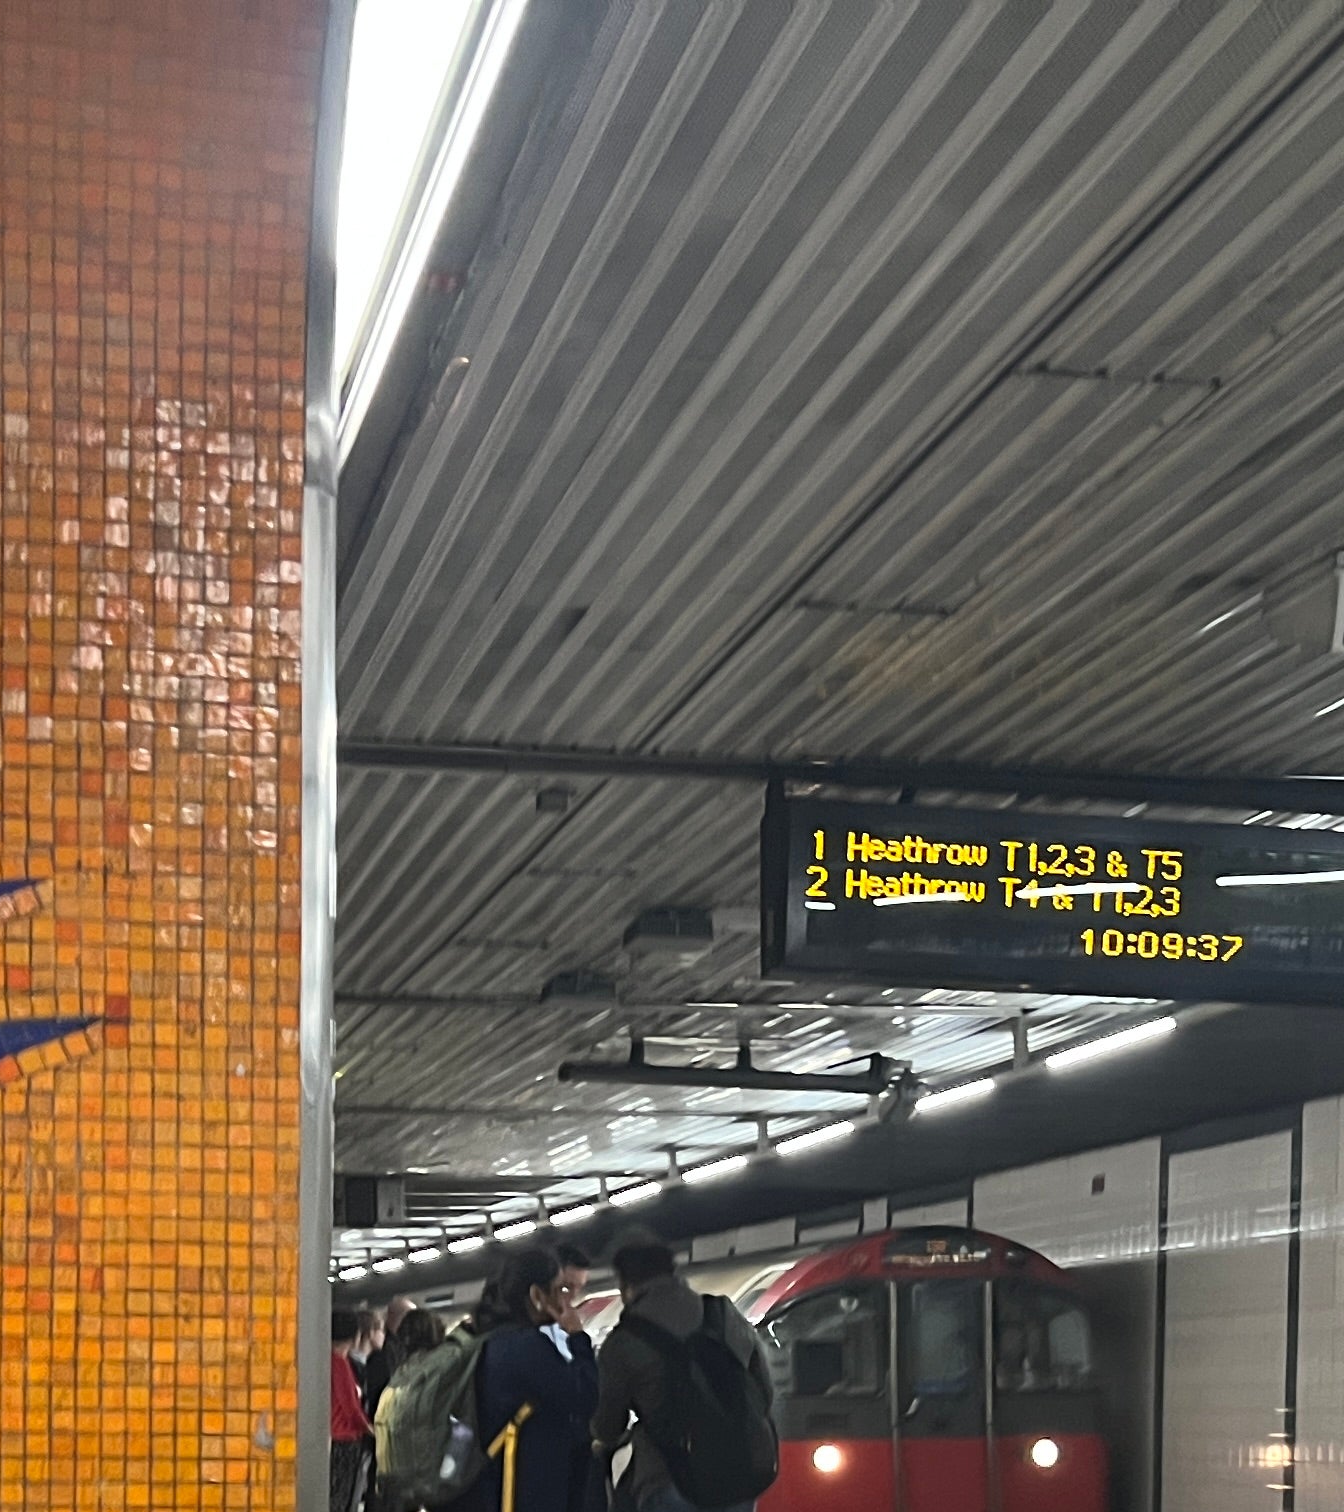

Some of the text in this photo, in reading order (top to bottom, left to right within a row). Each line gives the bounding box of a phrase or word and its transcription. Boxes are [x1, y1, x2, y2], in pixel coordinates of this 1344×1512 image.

[813, 829, 1183, 881] 1 Heathrow T1,2,3 & T5
[805, 865, 829, 897] 2
[845, 868, 986, 903] Heathrow
[997, 877, 1040, 909] T4
[1052, 883, 1074, 911] &
[1080, 928, 1243, 962] 10:09:37
